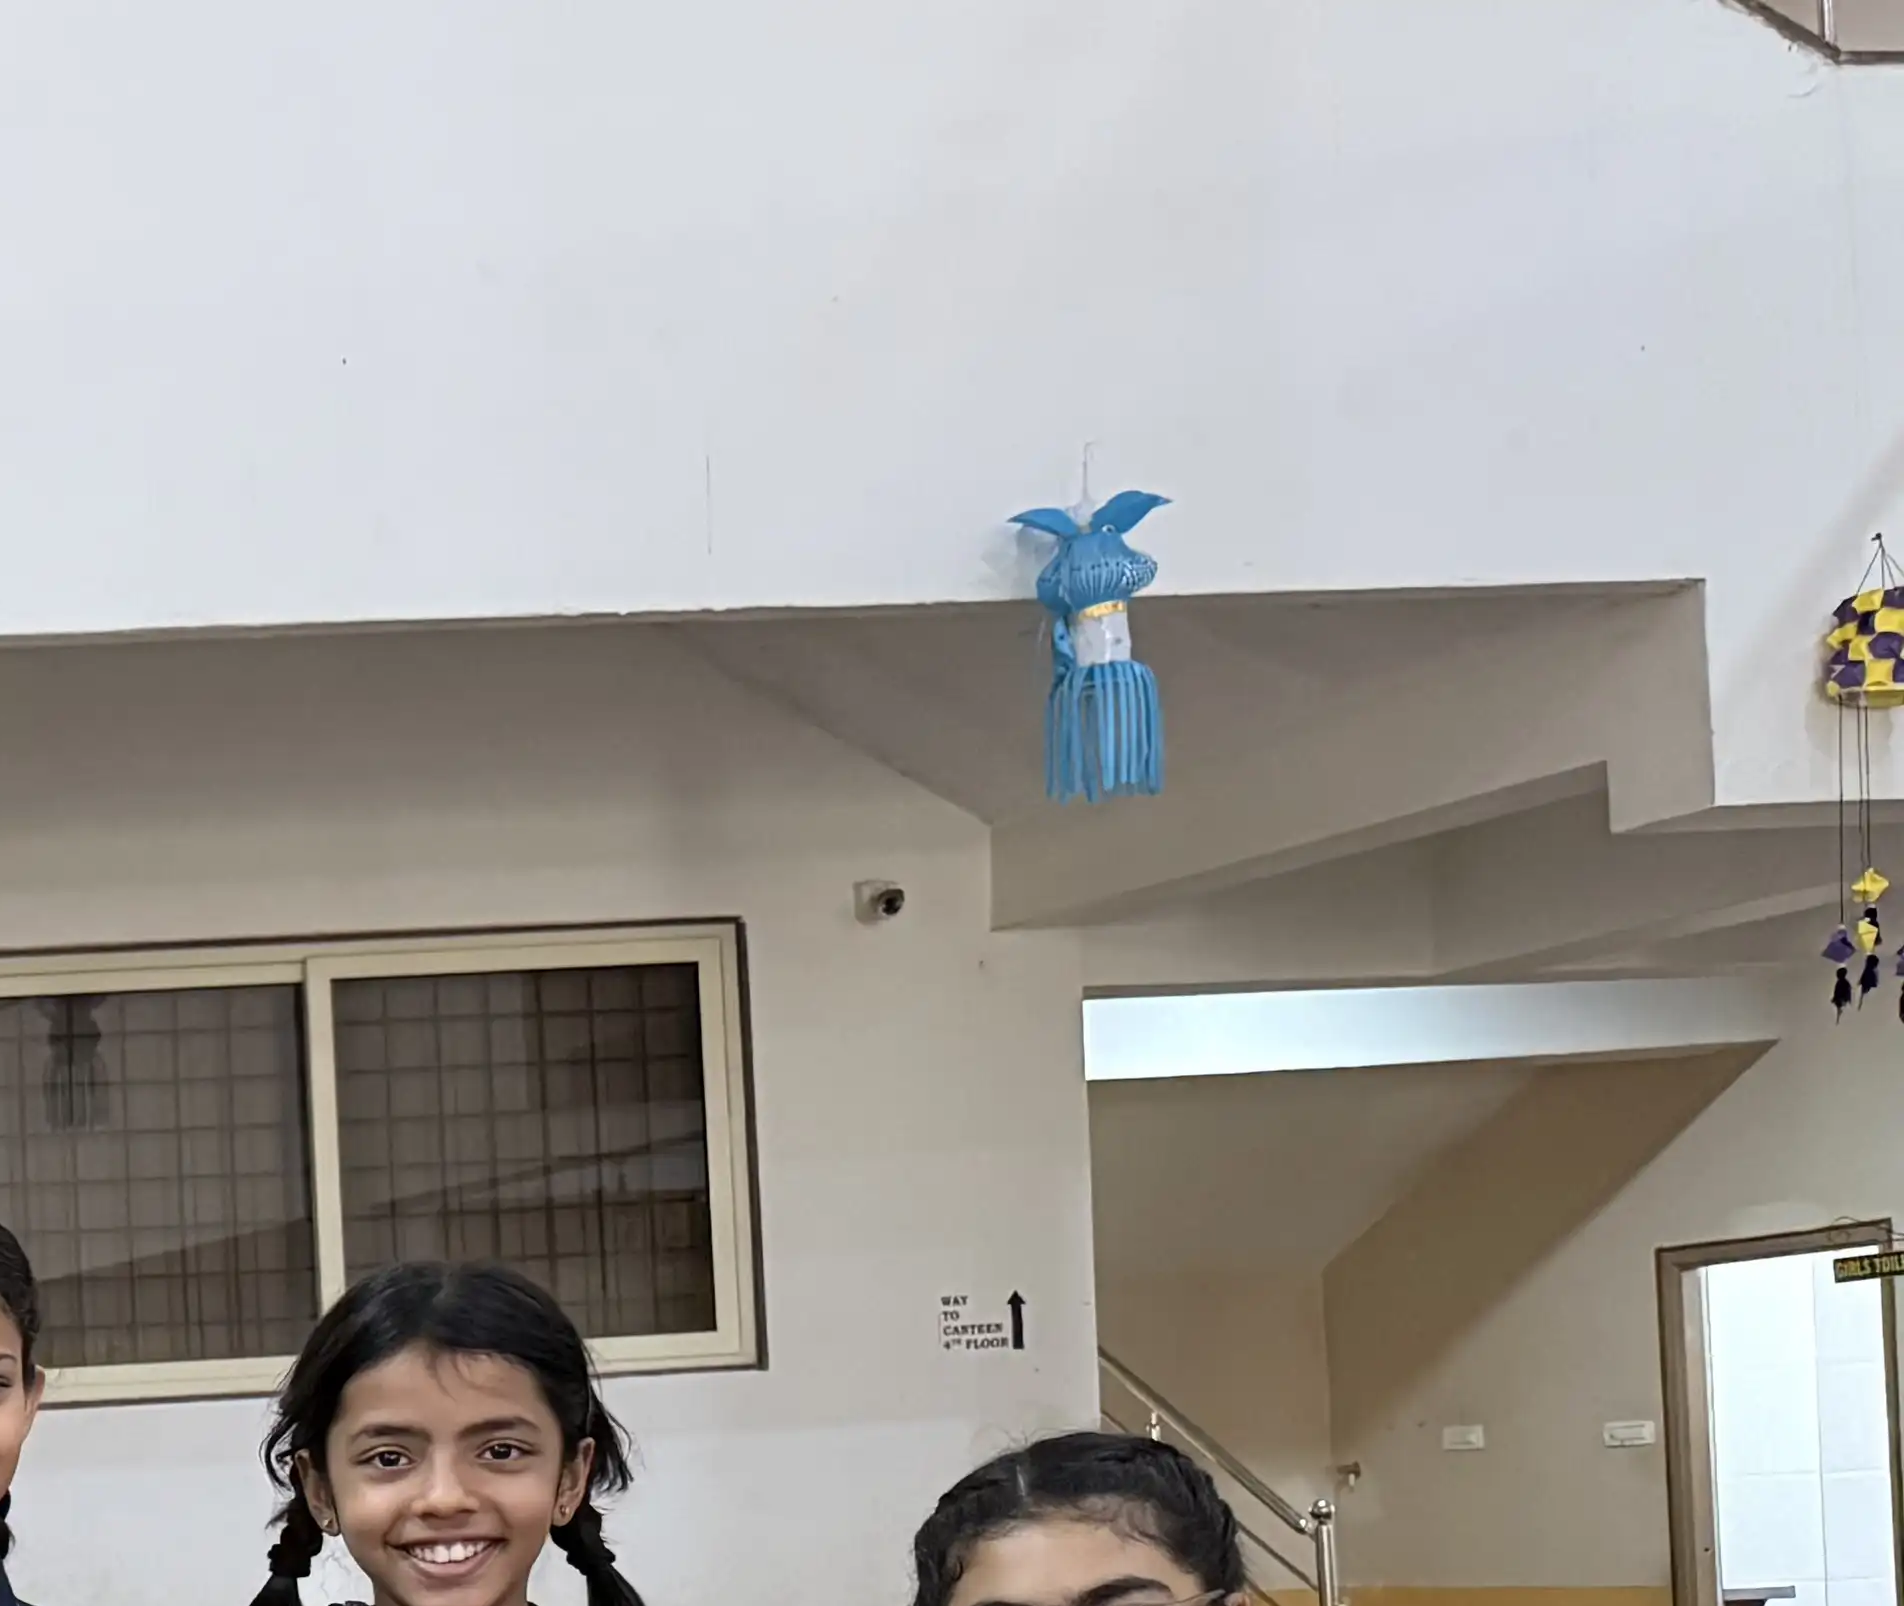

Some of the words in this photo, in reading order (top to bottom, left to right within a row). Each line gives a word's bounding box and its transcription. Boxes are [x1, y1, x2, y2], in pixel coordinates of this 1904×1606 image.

[941, 1296, 968, 1306] WAY
[943, 1310, 960, 1321] TO
[943, 1322, 1003, 1336] CANTEEN
[965, 1337, 1010, 1351] FLOOR
